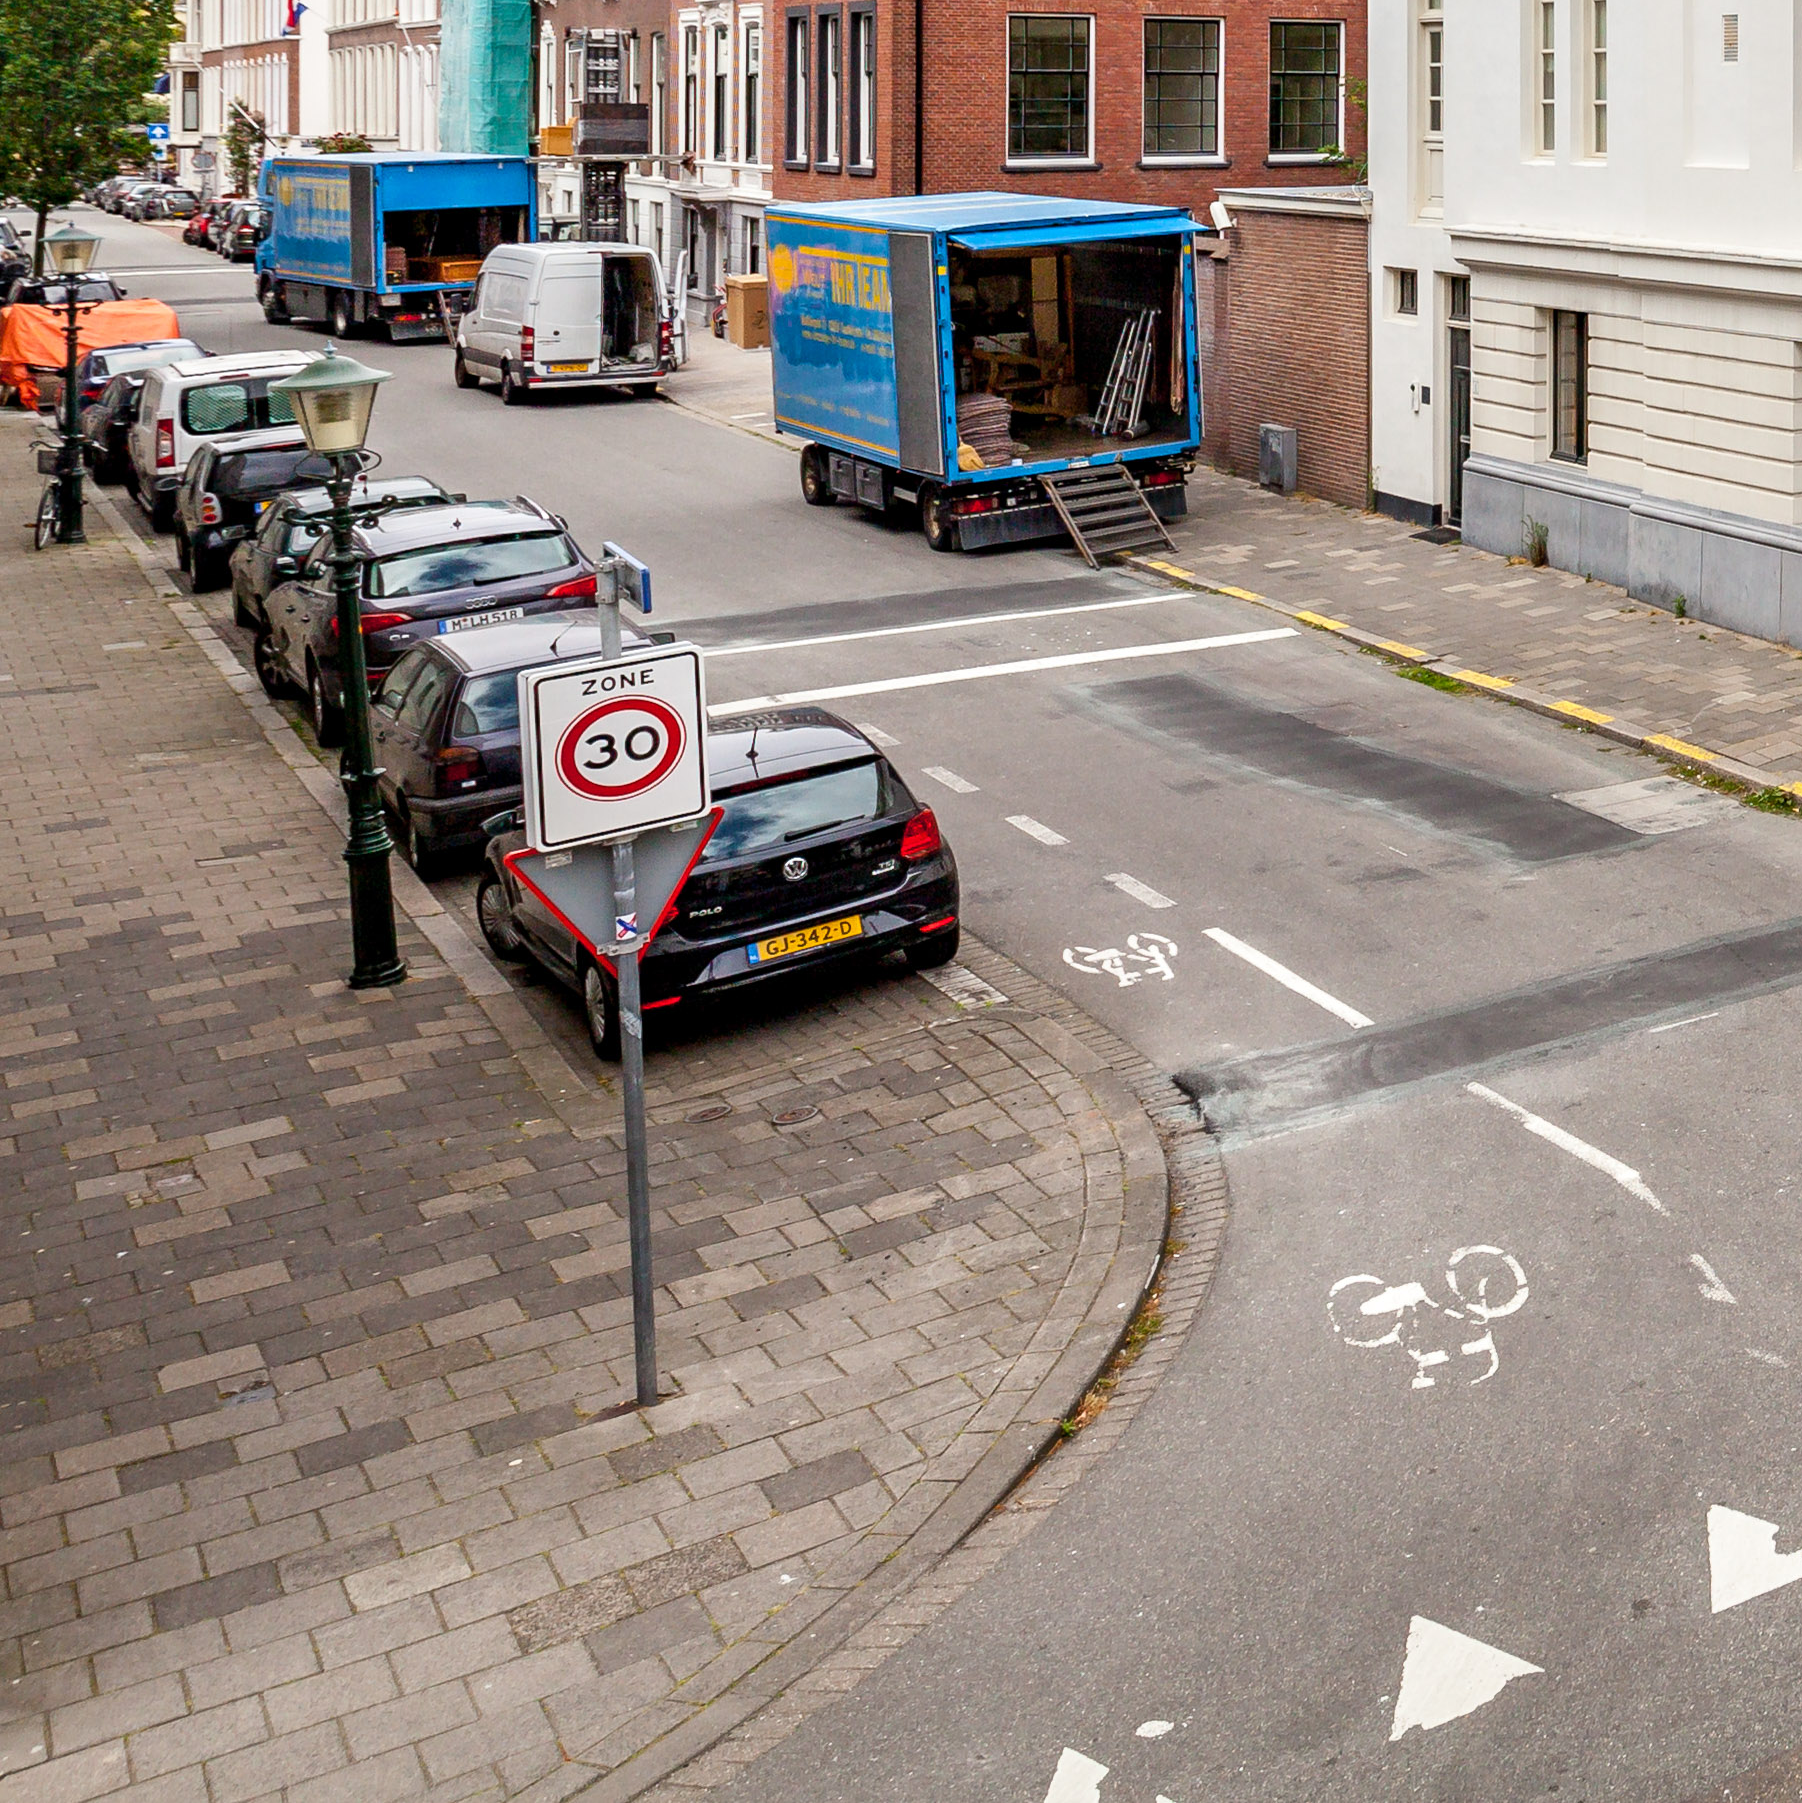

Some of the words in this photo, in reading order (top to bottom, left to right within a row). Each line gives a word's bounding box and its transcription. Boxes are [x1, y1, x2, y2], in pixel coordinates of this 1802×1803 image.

[582, 668, 654, 696] ZONE
[583, 725, 660, 769] 30
[689, 906, 723, 919] POLO
[766, 921, 852, 956] GJ-342-D
